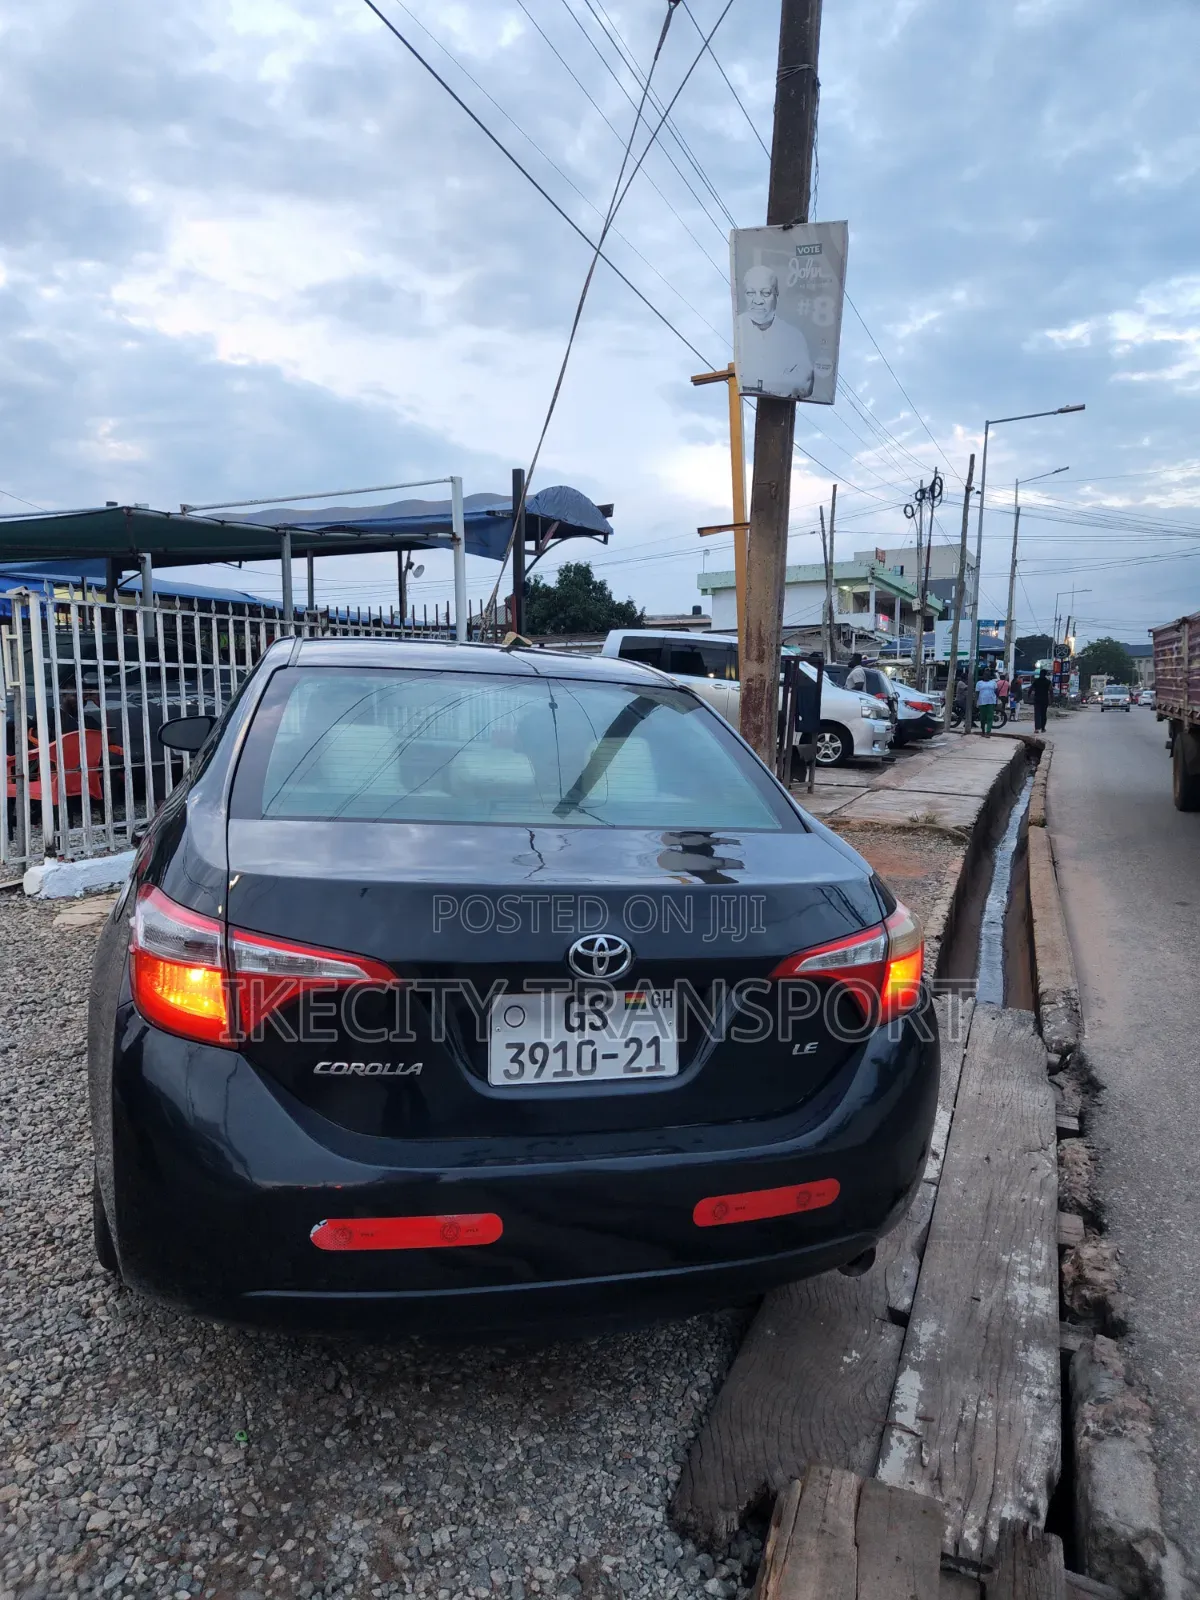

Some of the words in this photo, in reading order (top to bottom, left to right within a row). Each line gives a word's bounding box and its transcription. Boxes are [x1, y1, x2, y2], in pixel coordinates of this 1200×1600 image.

[797, 246, 820, 254] VOTE
[788, 257, 831, 287] John
[796, 296, 836, 327] #8
[651, 990, 673, 1009] GH
[565, 994, 609, 1033] GS
[503, 1036, 666, 1080] 3910-21
[792, 1041, 819, 1056] LE
[313, 1062, 423, 1077] COROLLA
